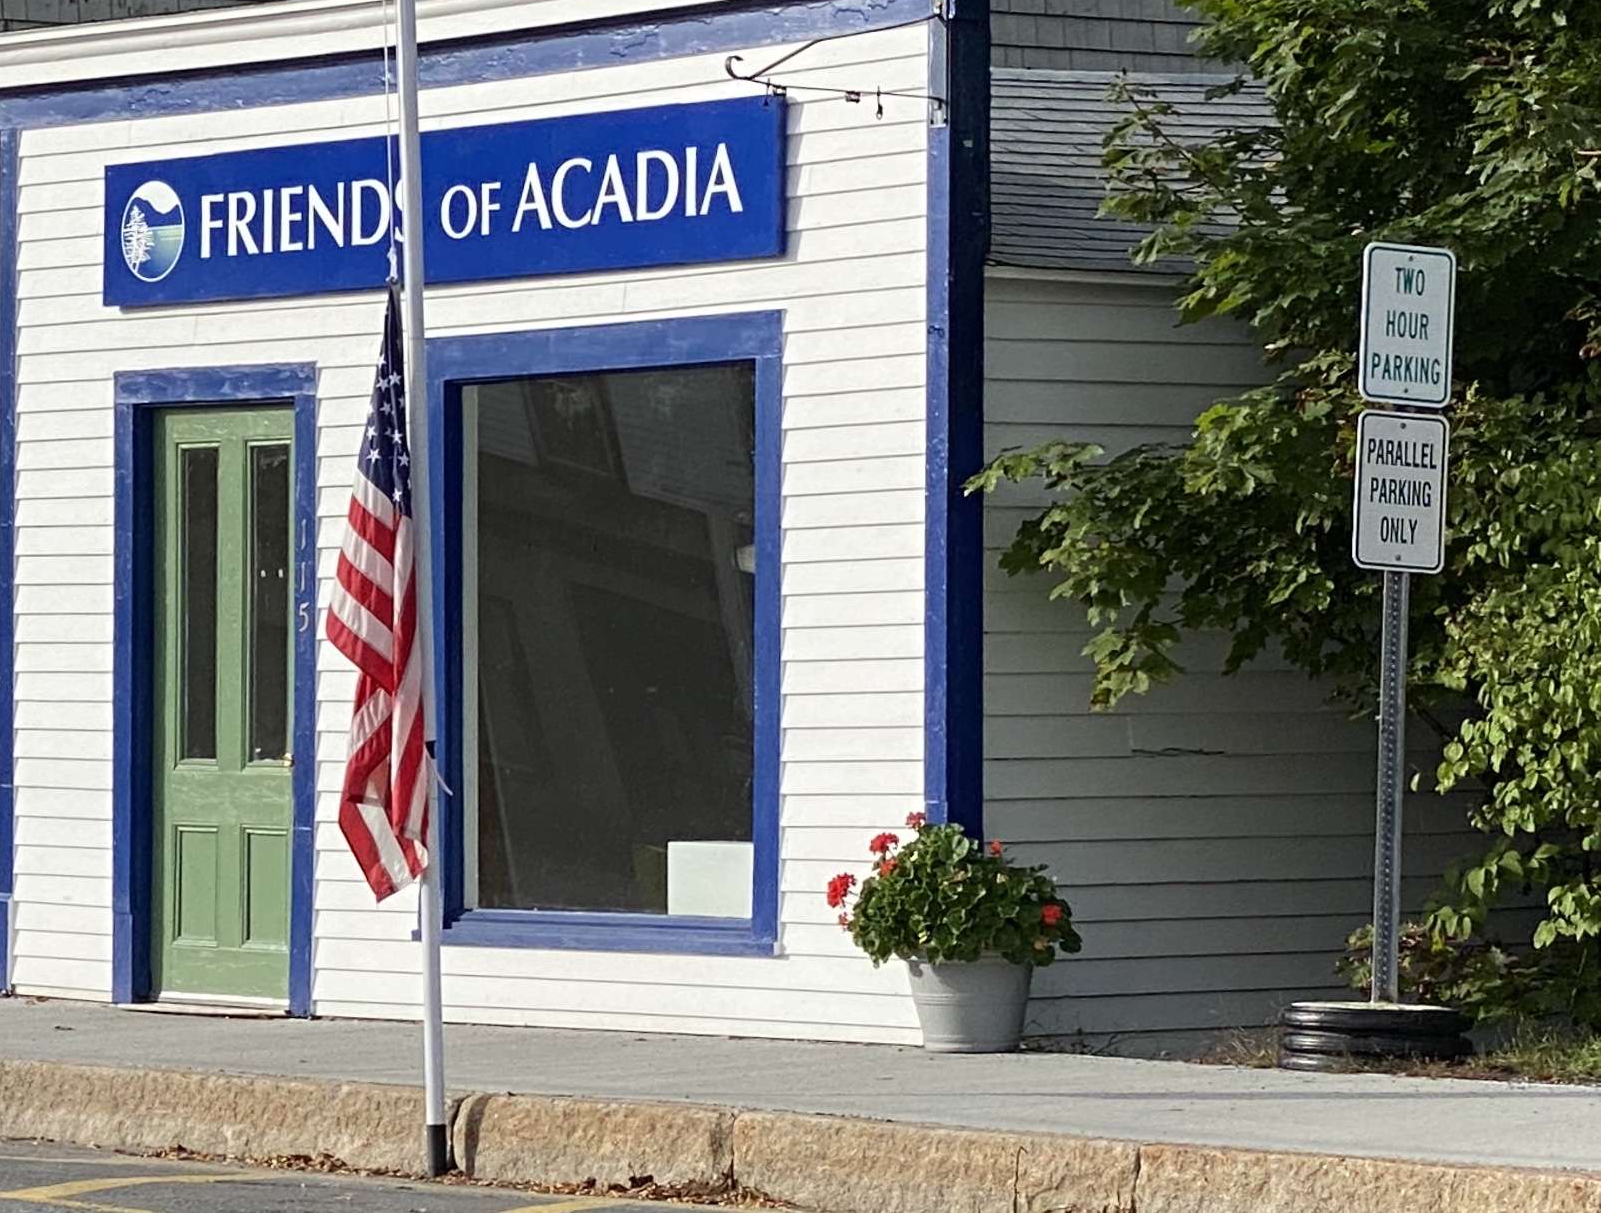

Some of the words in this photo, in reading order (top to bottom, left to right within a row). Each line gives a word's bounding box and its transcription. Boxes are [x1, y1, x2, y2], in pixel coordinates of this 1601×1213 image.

[440, 182, 501, 239] OF
[511, 142, 743, 232] ACADIA
[1395, 266, 1426, 297] TWO
[1385, 309, 1430, 340] HOUR
[1370, 352, 1441, 385] PARKING
[1367, 437, 1438, 470] PARALLEL
[1370, 477, 1432, 508] PARKING
[1380, 515, 1418, 545] ONLY
